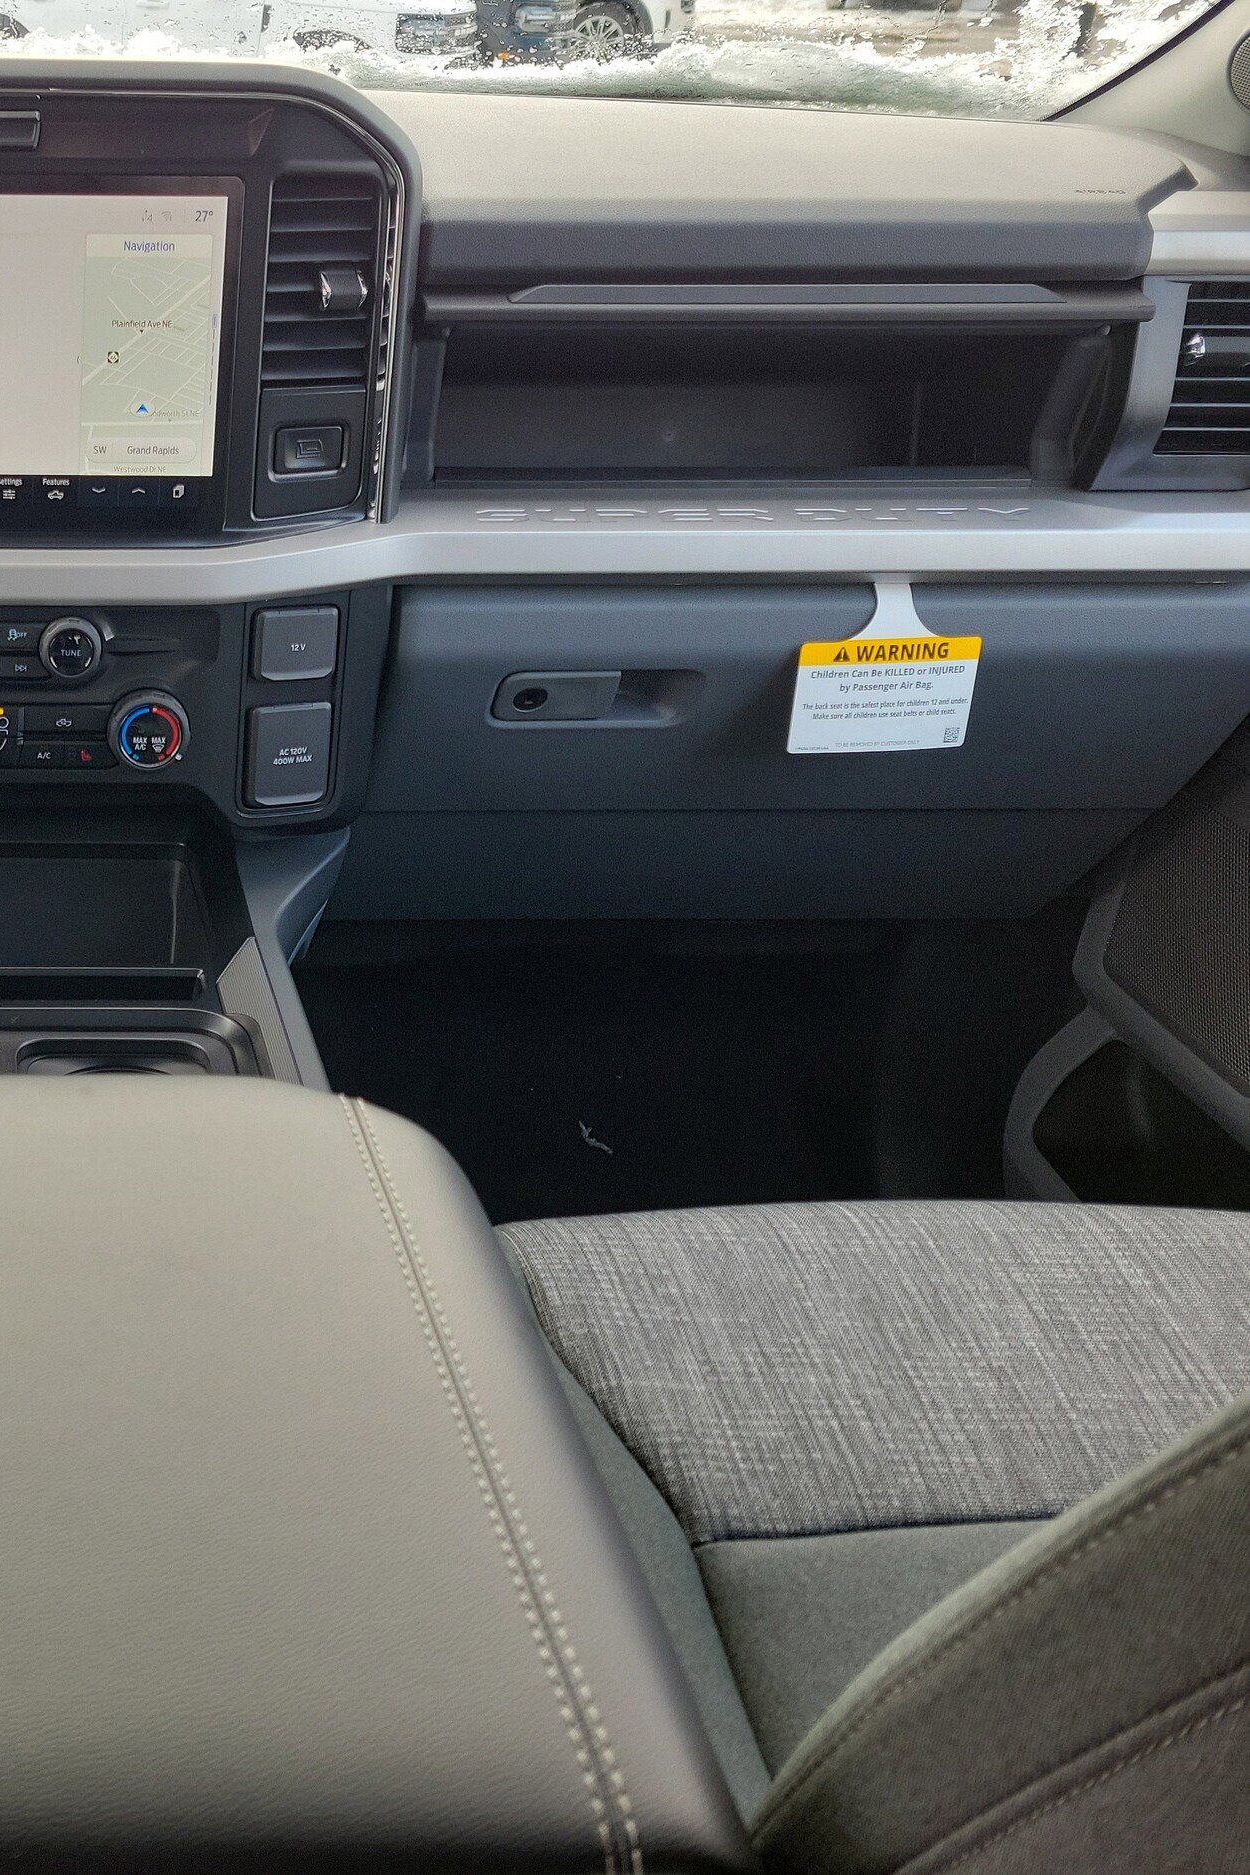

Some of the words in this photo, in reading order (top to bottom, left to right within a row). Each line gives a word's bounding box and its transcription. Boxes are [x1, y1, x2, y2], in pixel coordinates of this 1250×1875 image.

[123, 240, 175, 253] Navigation
[111, 319, 146, 329] Plainfield
[147, 319, 162, 329] Ave
[162, 320, 173, 328] NE
[93, 446, 107, 455] SW
[127, 445, 151, 455] Grand
[152, 446, 180, 456] Rapids
[113, 465, 148, 473] Westwood
[42, 478, 70, 486] Features
[475, 507, 775, 523] SUPER
[794, 507, 1031, 522] DUTY
[291, 643, 300, 652] 12
[300, 643, 306, 651] V
[856, 642, 950, 662] WARNING
[60, 649, 82, 658] TUNE
[811, 670, 850, 680] Children
[852, 669, 869, 679] Can
[871, 669, 883, 678] Be
[884, 668, 915, 677] KILLED
[928, 665, 966, 675] INJURED
[839, 683, 851, 693] by
[853, 682, 898, 693] Passenger
[900, 681, 914, 690] Air
[915, 681, 934, 691] Bag.
[861, 701, 879, 709] safest
[879, 701, 896, 709] place
[906, 699, 930, 707] children
[853, 711, 878, 719] children
[889, 710, 903, 718] seat
[903, 709, 918, 717] belts
[926, 708, 940, 716] child
[133, 736, 148, 744] MAX
[151, 736, 166, 744] MAX
[134, 743, 147, 751] A/C
[279, 748, 289, 756] AC
[290, 746, 308, 755] 120V
[37, 751, 52, 760] A/C
[273, 756, 295, 766] 400W
[295, 754, 313, 764] MAX
